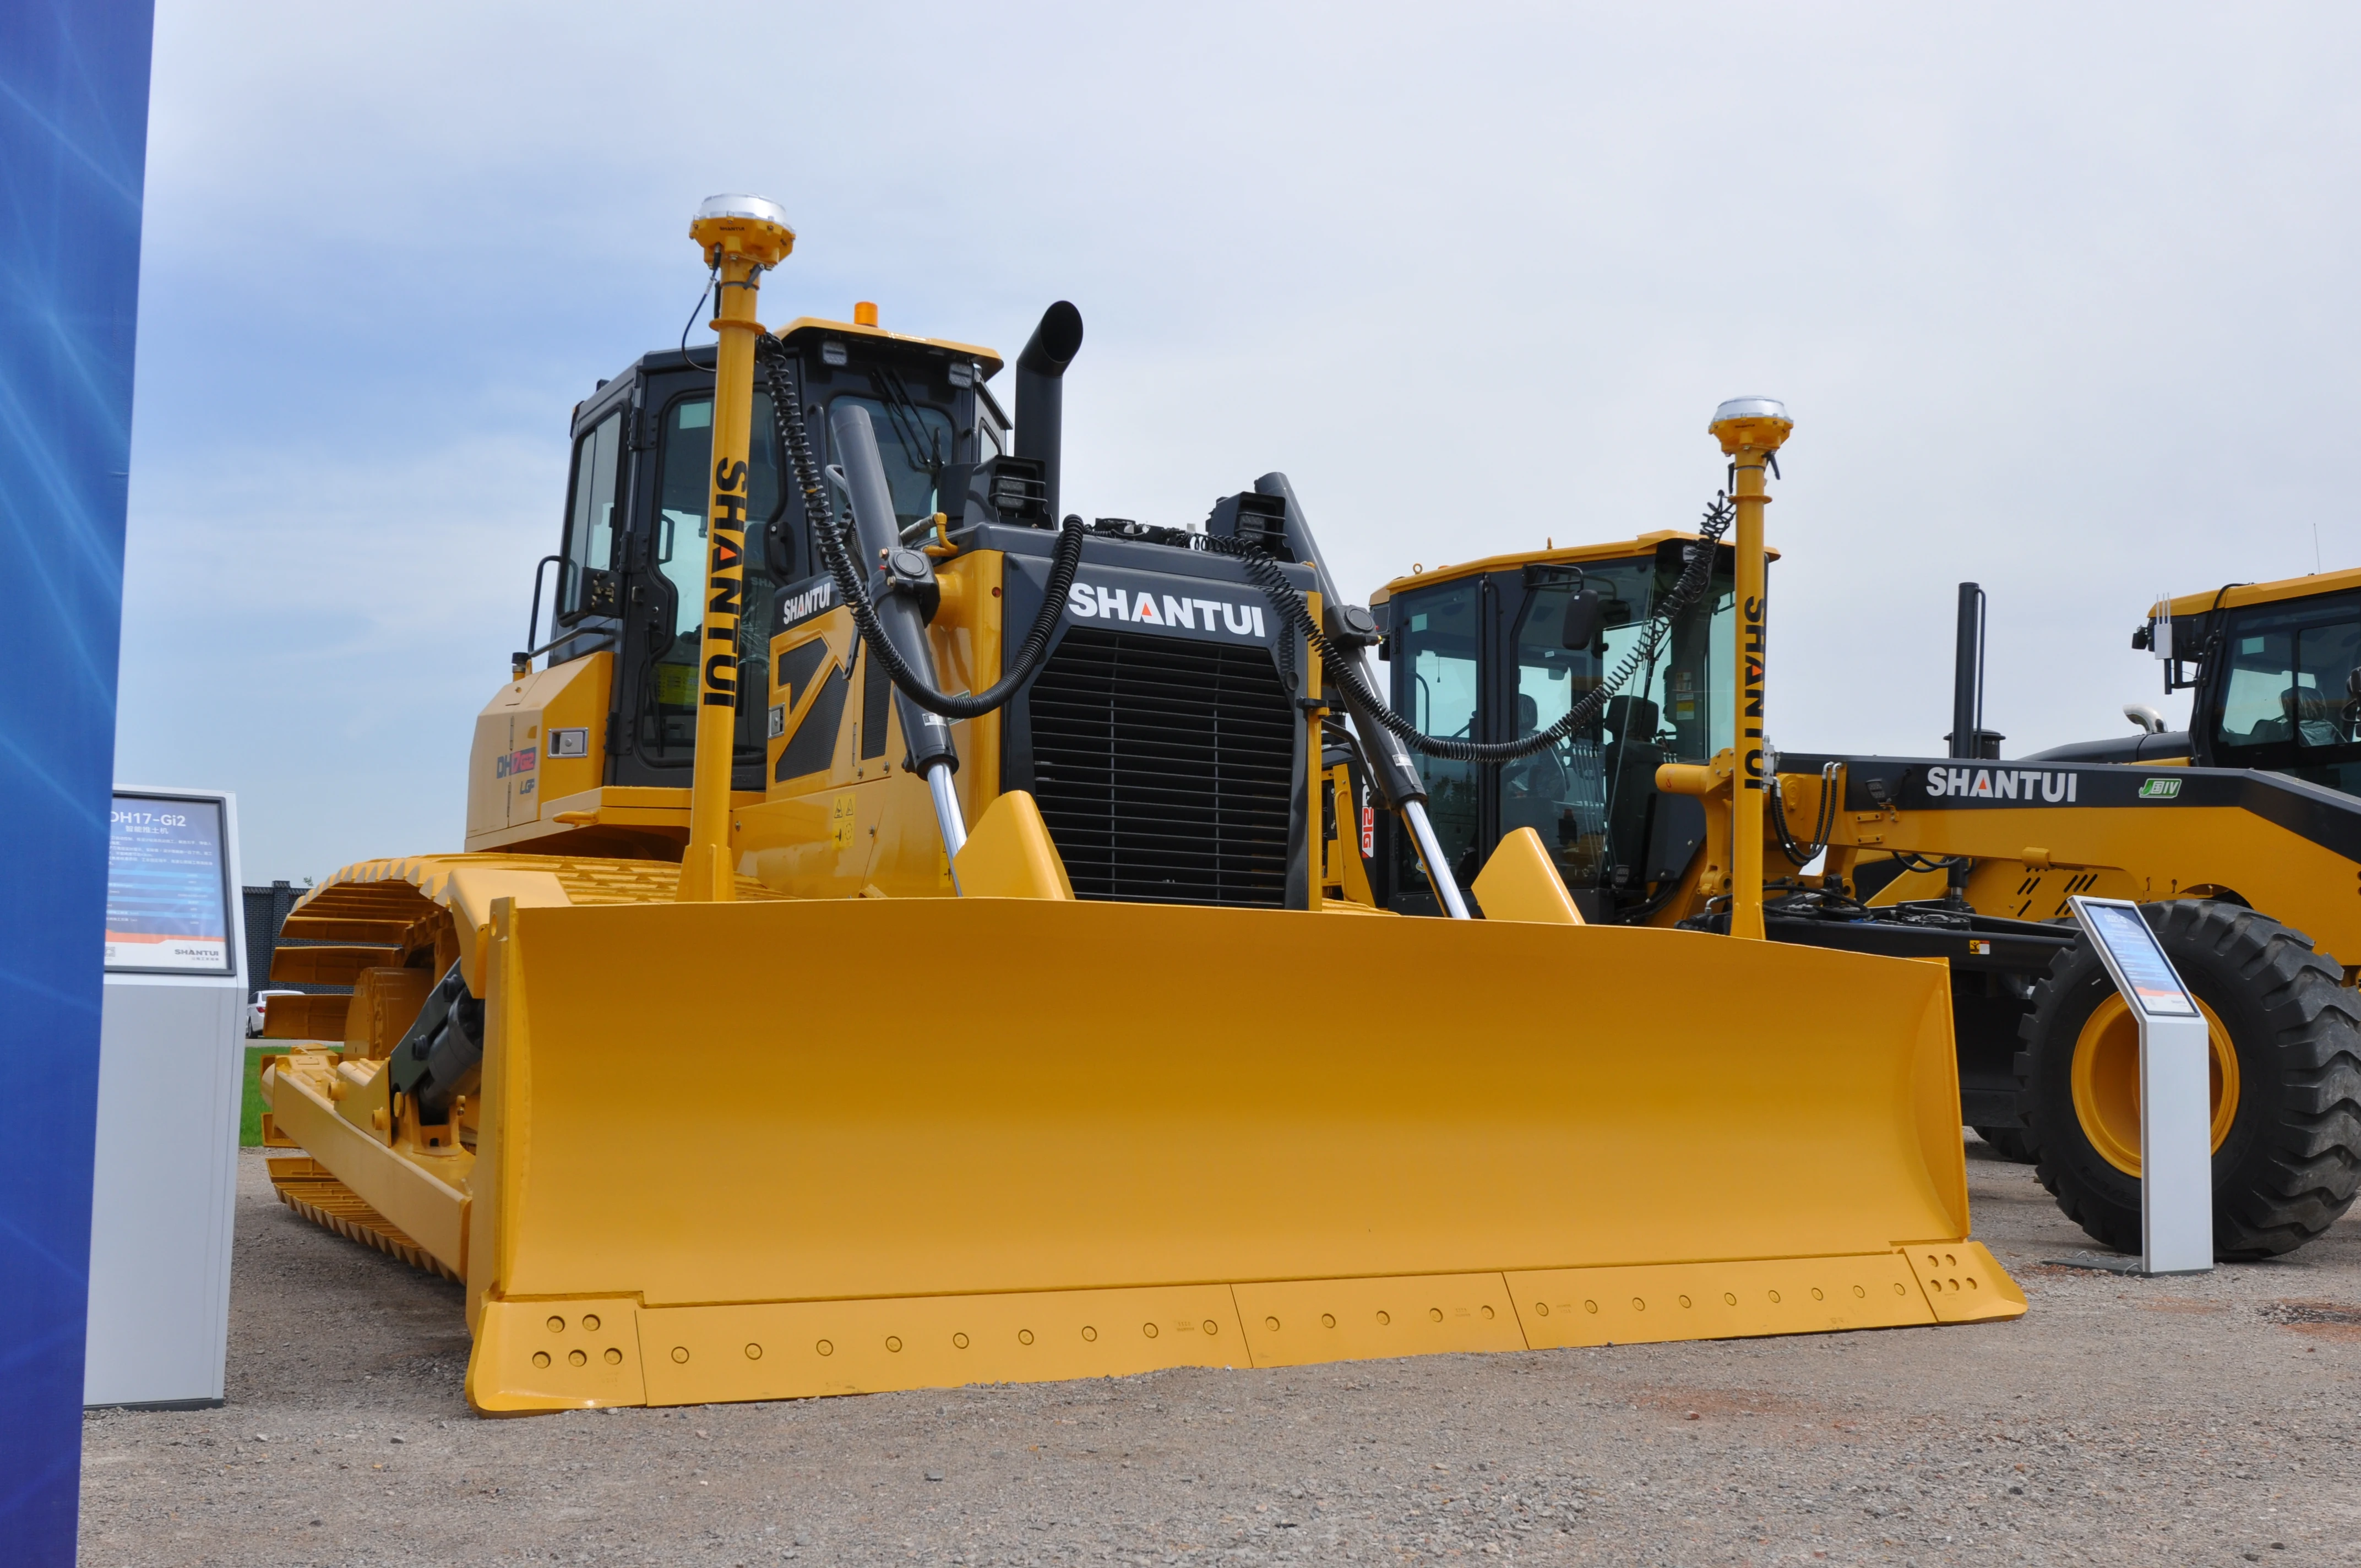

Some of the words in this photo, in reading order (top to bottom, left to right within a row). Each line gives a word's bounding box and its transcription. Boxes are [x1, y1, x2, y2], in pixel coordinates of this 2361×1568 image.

[704, 457, 748, 707] SHANTUI
[784, 582, 830, 625] SHANTUI
[1068, 582, 1266, 638] SHANTUI
[1926, 767, 2077, 802] SHANTUI
